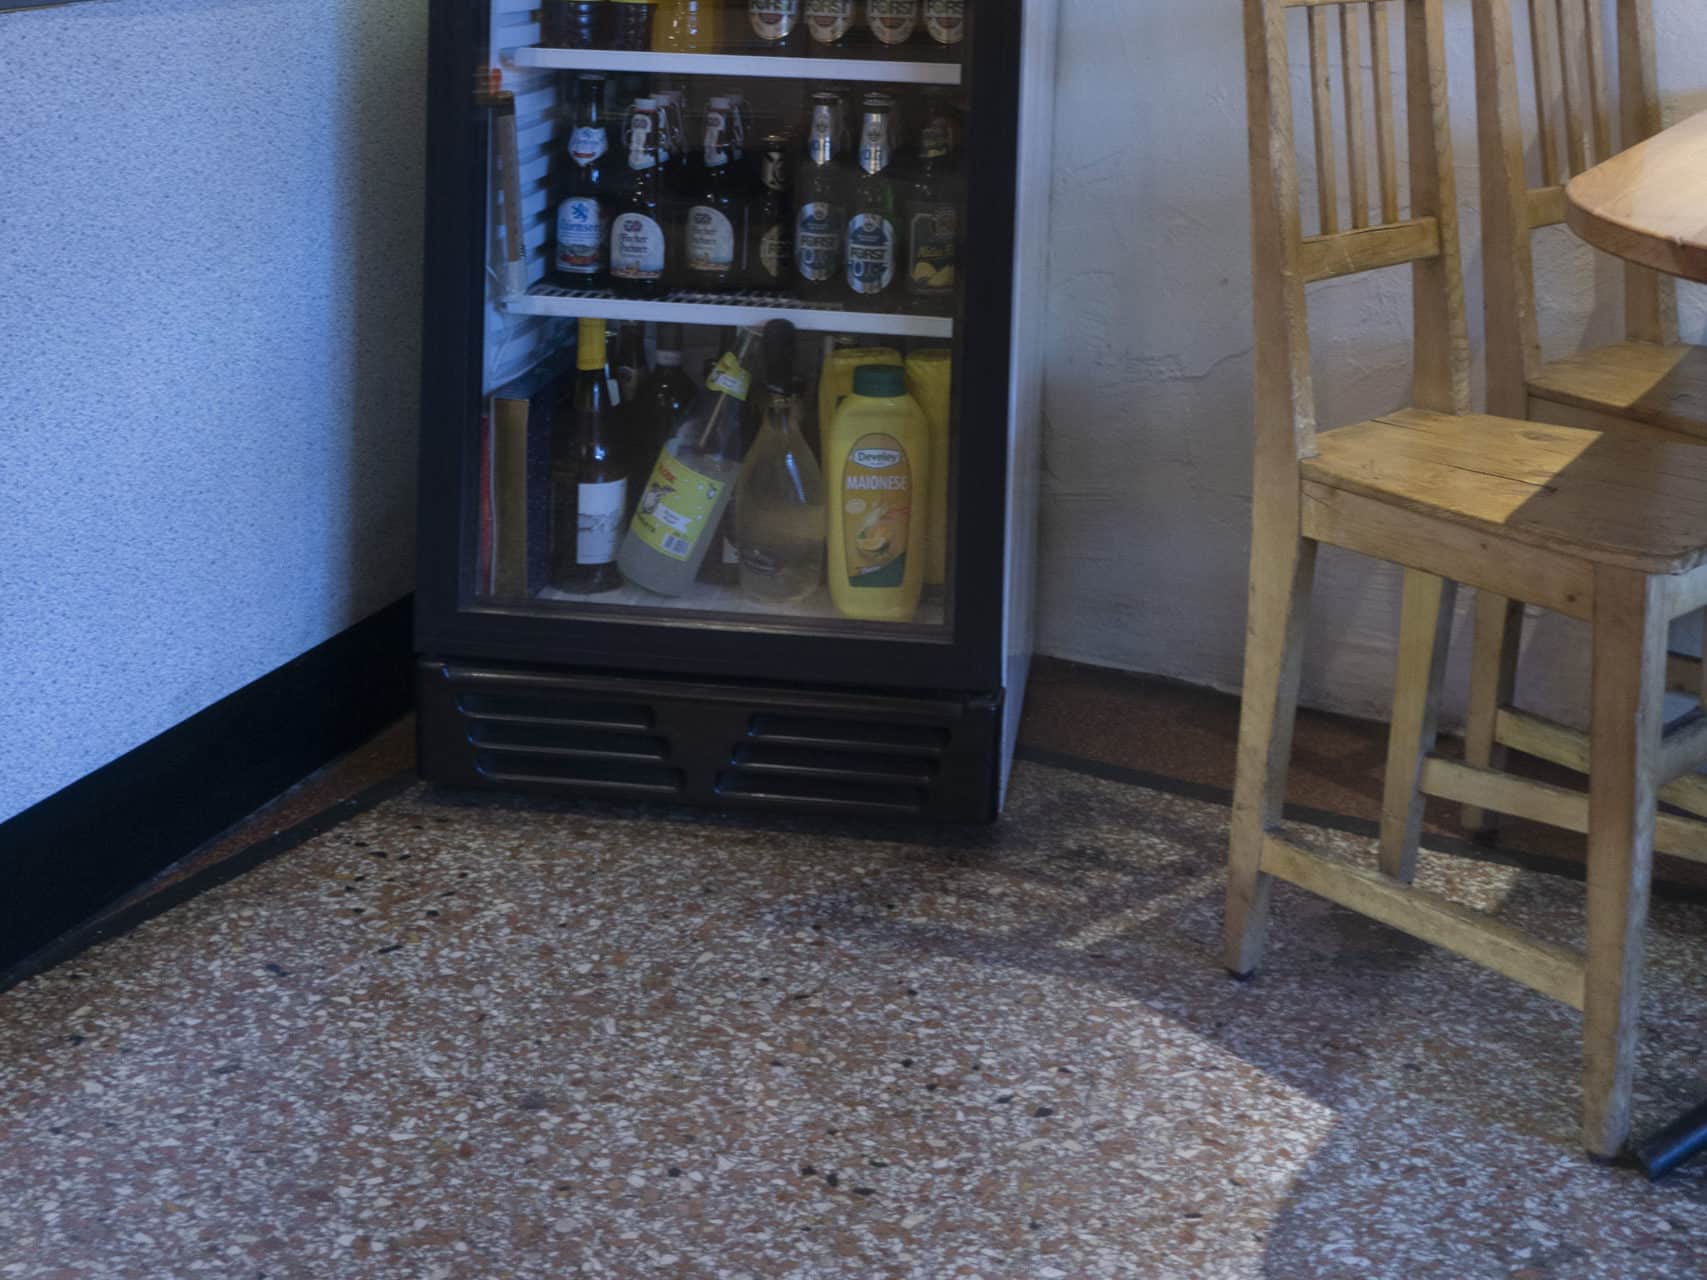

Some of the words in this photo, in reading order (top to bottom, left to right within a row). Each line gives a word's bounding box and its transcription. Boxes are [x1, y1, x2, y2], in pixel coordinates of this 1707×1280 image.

[870, 0, 913, 16] FORST
[927, 0, 965, 16] FORS
[850, 247, 887, 260] FORST
[847, 475, 908, 490] MAIONESE
